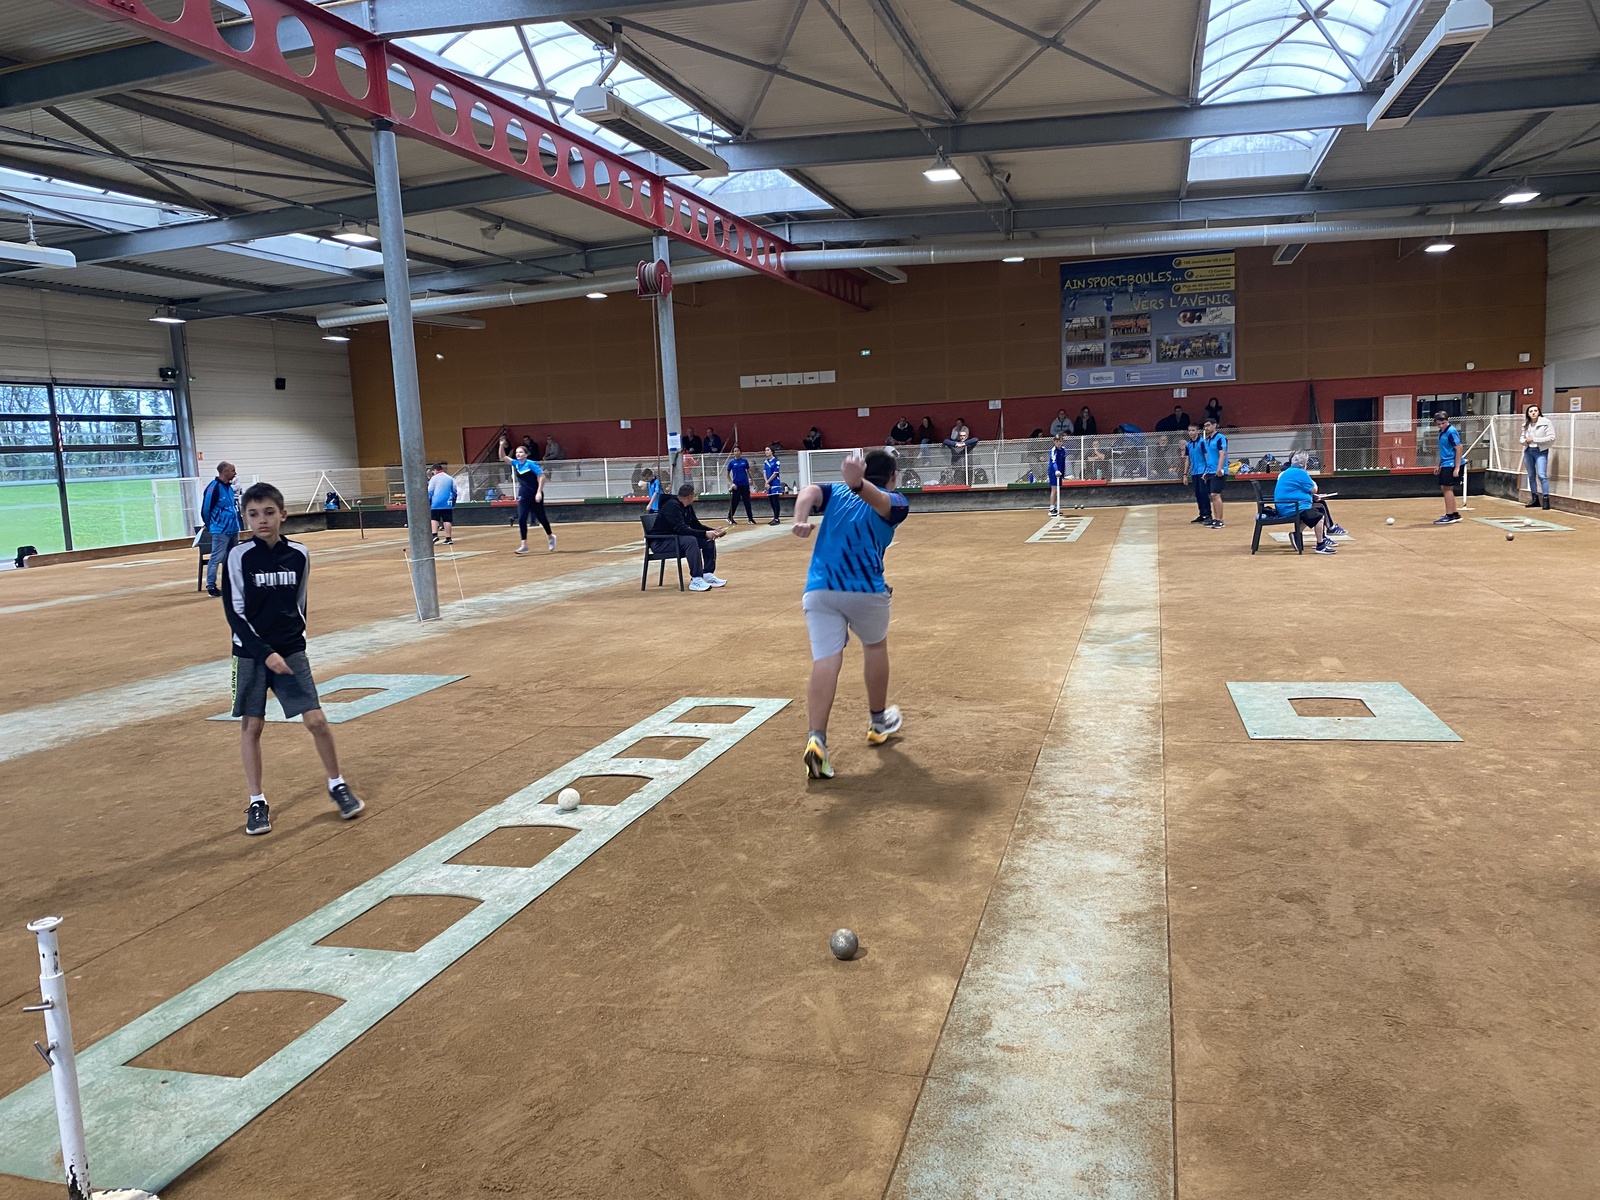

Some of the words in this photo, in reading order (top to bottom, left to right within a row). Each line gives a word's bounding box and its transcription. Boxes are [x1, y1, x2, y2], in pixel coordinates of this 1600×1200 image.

[1064, 279, 1086, 290] AIN
[1170, 294, 1232, 308] L'AVENIR
[255, 571, 296, 587] PUMA
